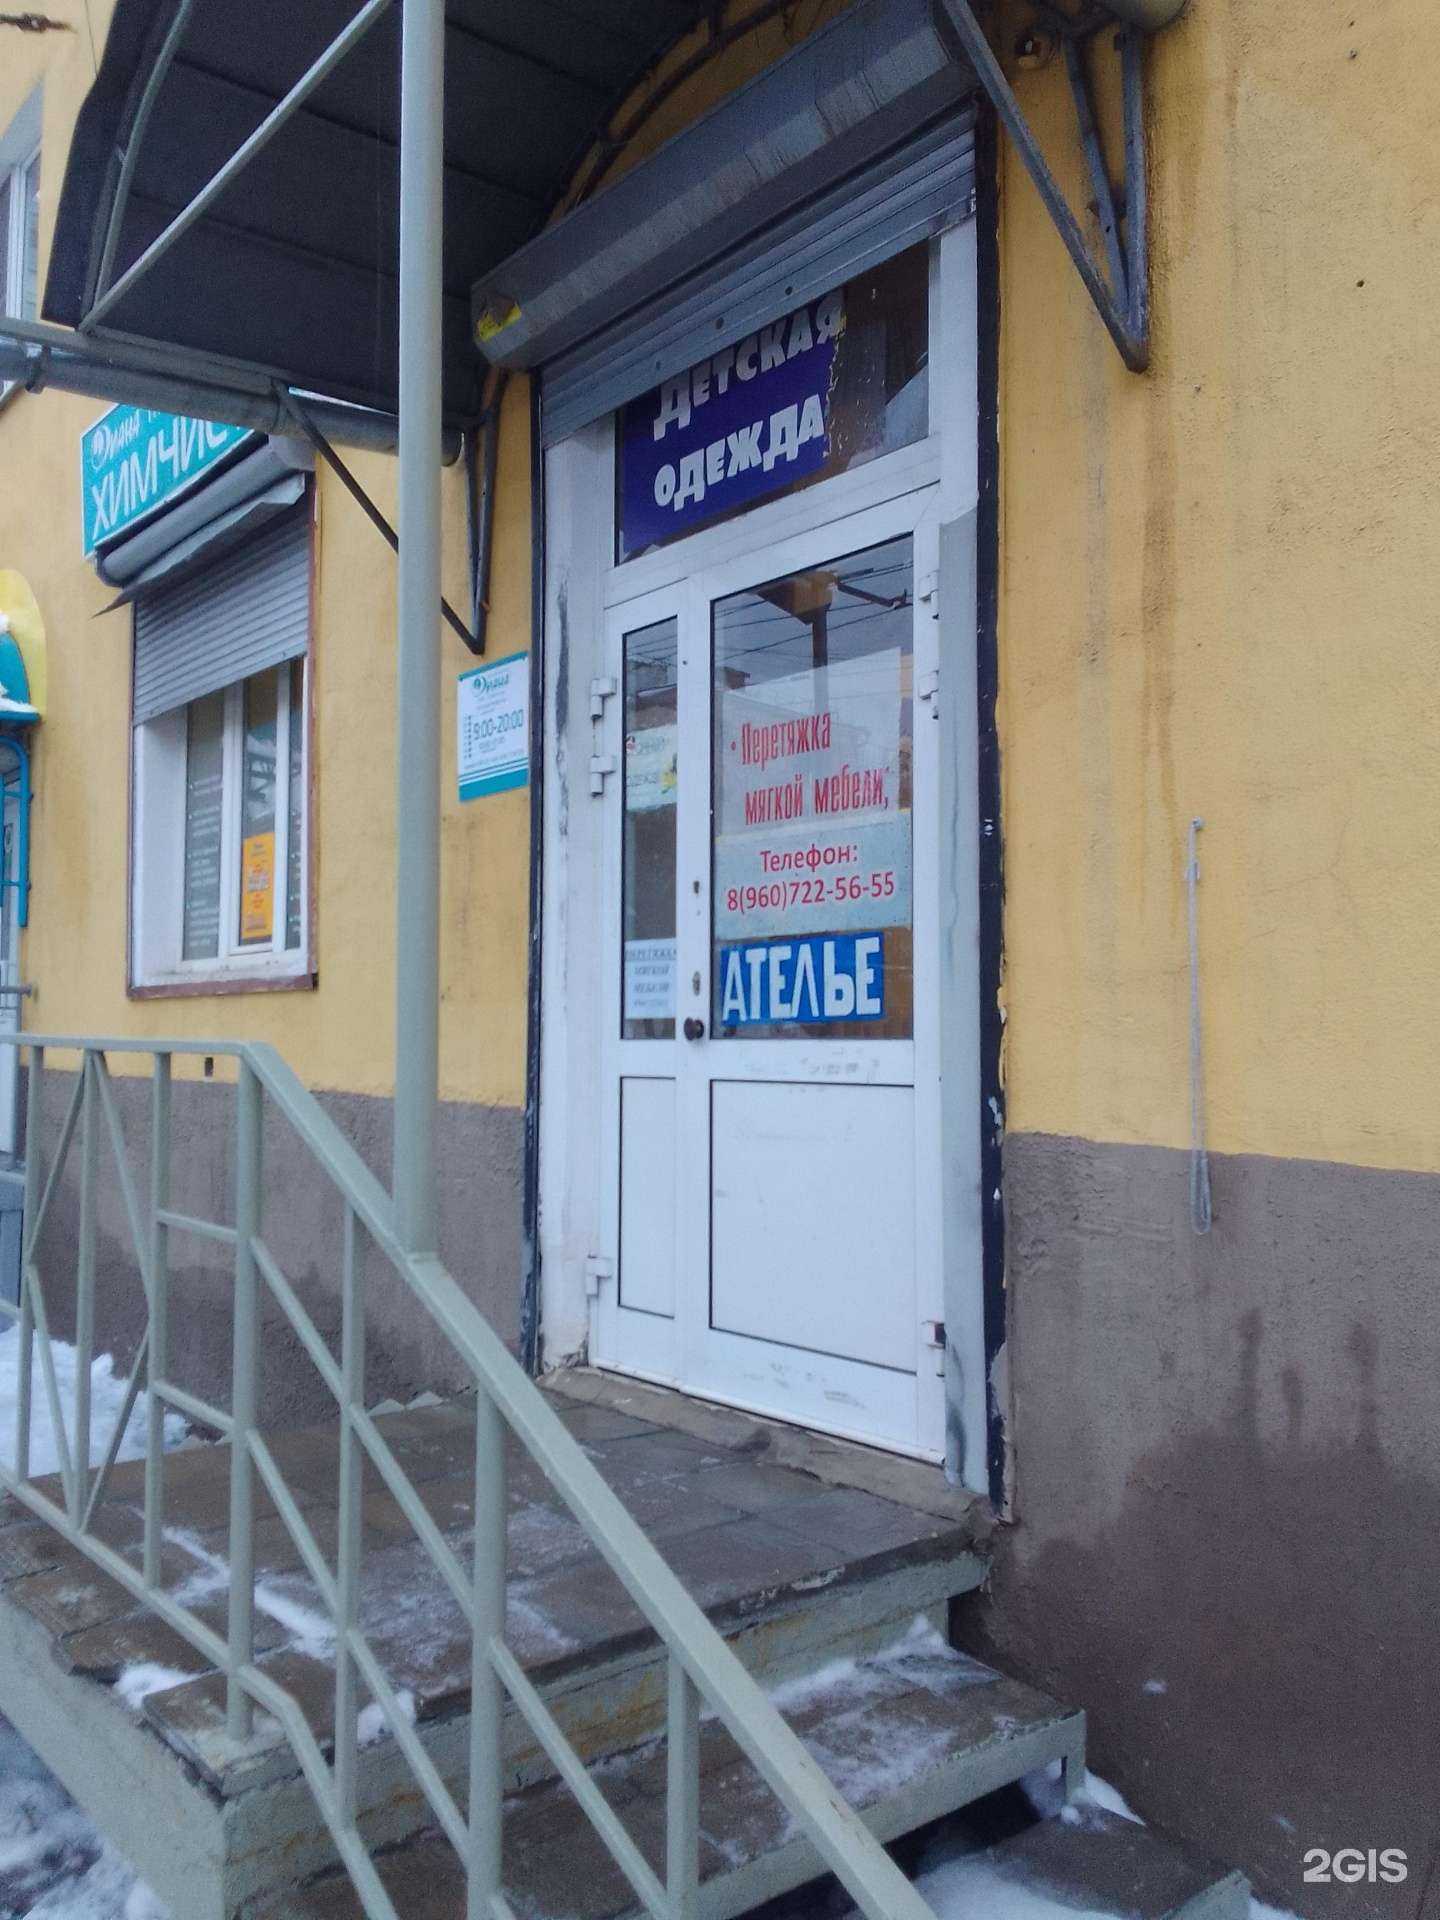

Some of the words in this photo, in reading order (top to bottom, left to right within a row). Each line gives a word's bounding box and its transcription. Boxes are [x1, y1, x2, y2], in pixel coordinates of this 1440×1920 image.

[653, 295, 843, 441] ДЕТСКАЯ
[92, 415, 241, 541] ХИМЧИС
[653, 393, 825, 512] ОДЕЖДА
[741, 711, 832, 772] Перетяжка
[745, 774, 804, 826] мягкой
[727, 871, 896, 914] 8(960)722-56-55
[760, 842, 859, 874] Телефон:
[721, 936, 882, 1023] АТЕЛЬЕ
